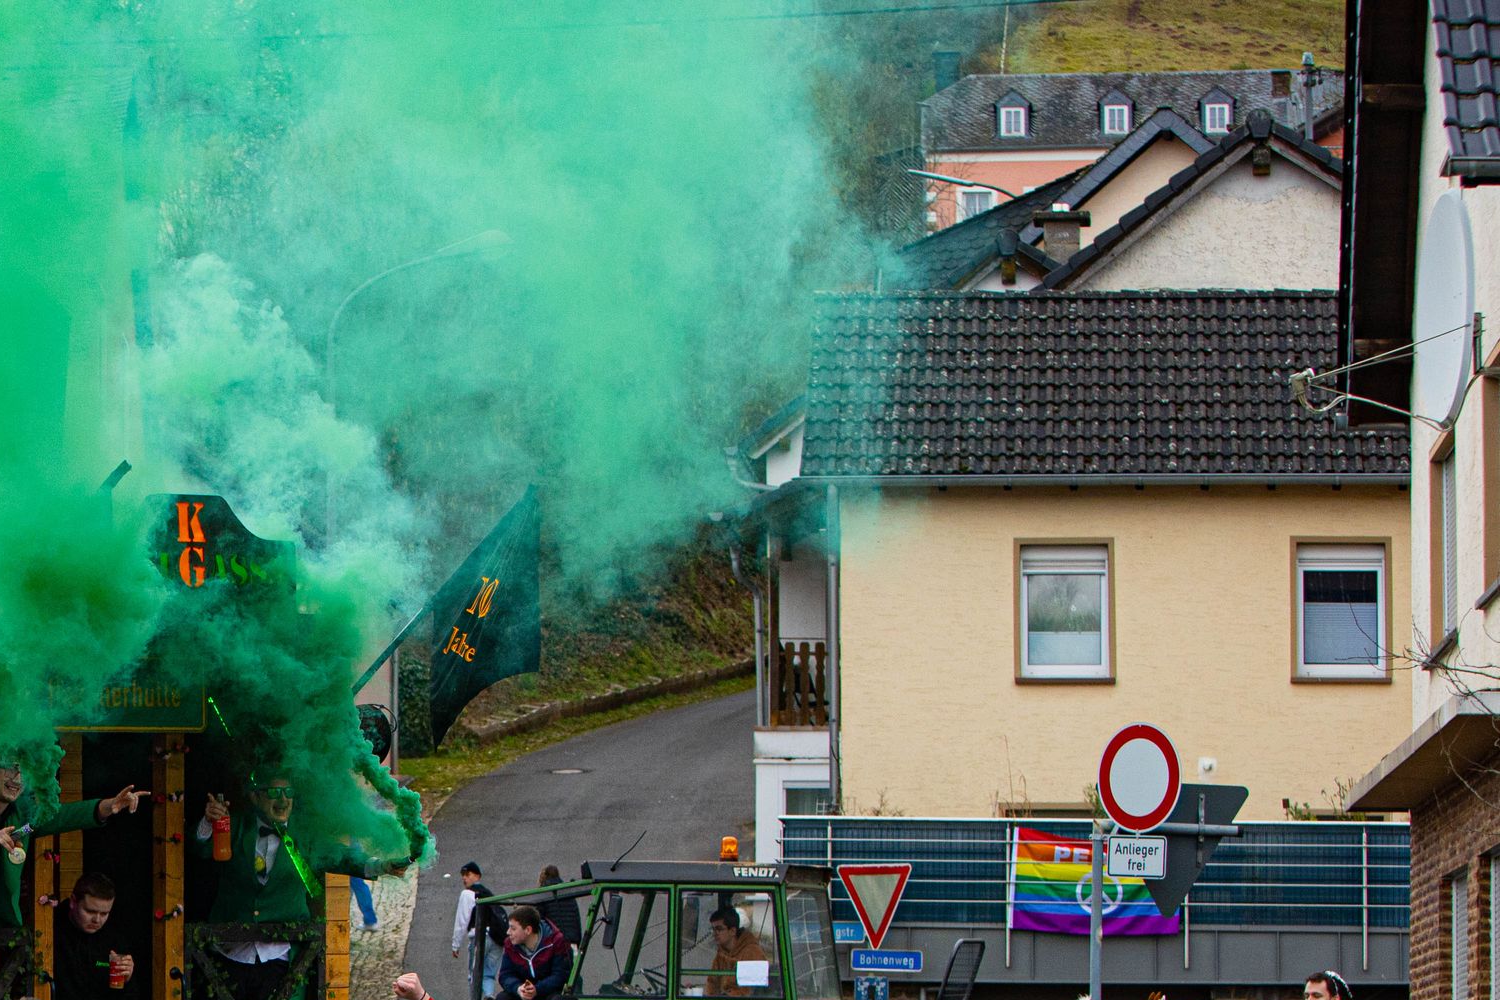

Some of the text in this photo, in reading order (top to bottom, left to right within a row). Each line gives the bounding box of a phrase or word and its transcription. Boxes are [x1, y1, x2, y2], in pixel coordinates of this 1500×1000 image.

[443, 626, 476, 662] Jahre
[1115, 843, 1159, 858] Anlieger
[1128, 859, 1146, 871] frei
[733, 867, 777, 878] FENDT
[859, 954, 914, 968] Bohnenweg
